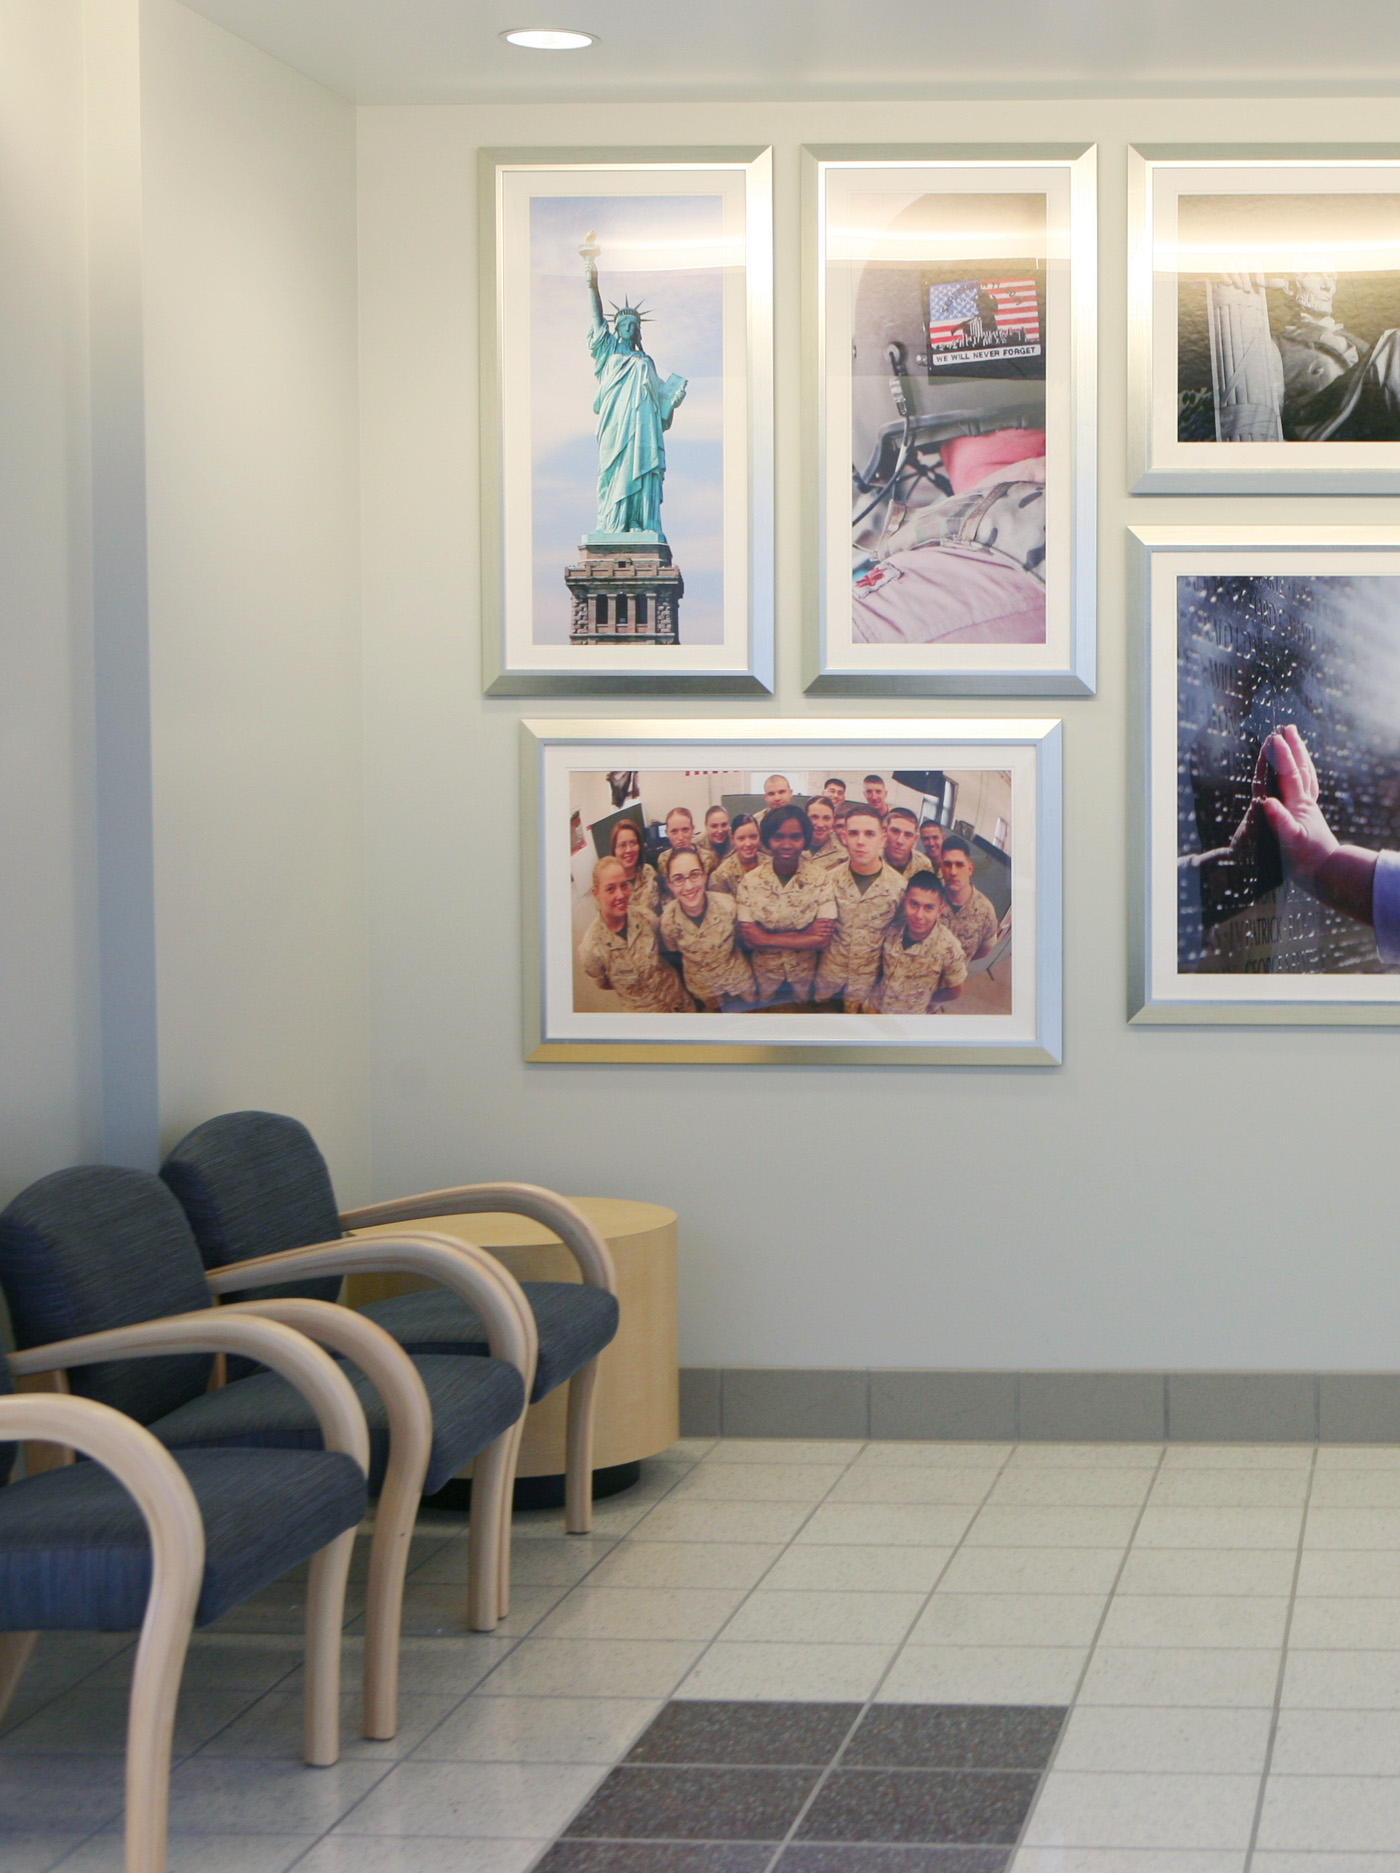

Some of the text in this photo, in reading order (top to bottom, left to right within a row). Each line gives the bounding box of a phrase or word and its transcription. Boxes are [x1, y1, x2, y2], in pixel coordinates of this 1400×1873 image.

[936, 346, 1036, 363] WE WILL NEVER FORGET
[1245, 914, 1282, 949] PATRICK
